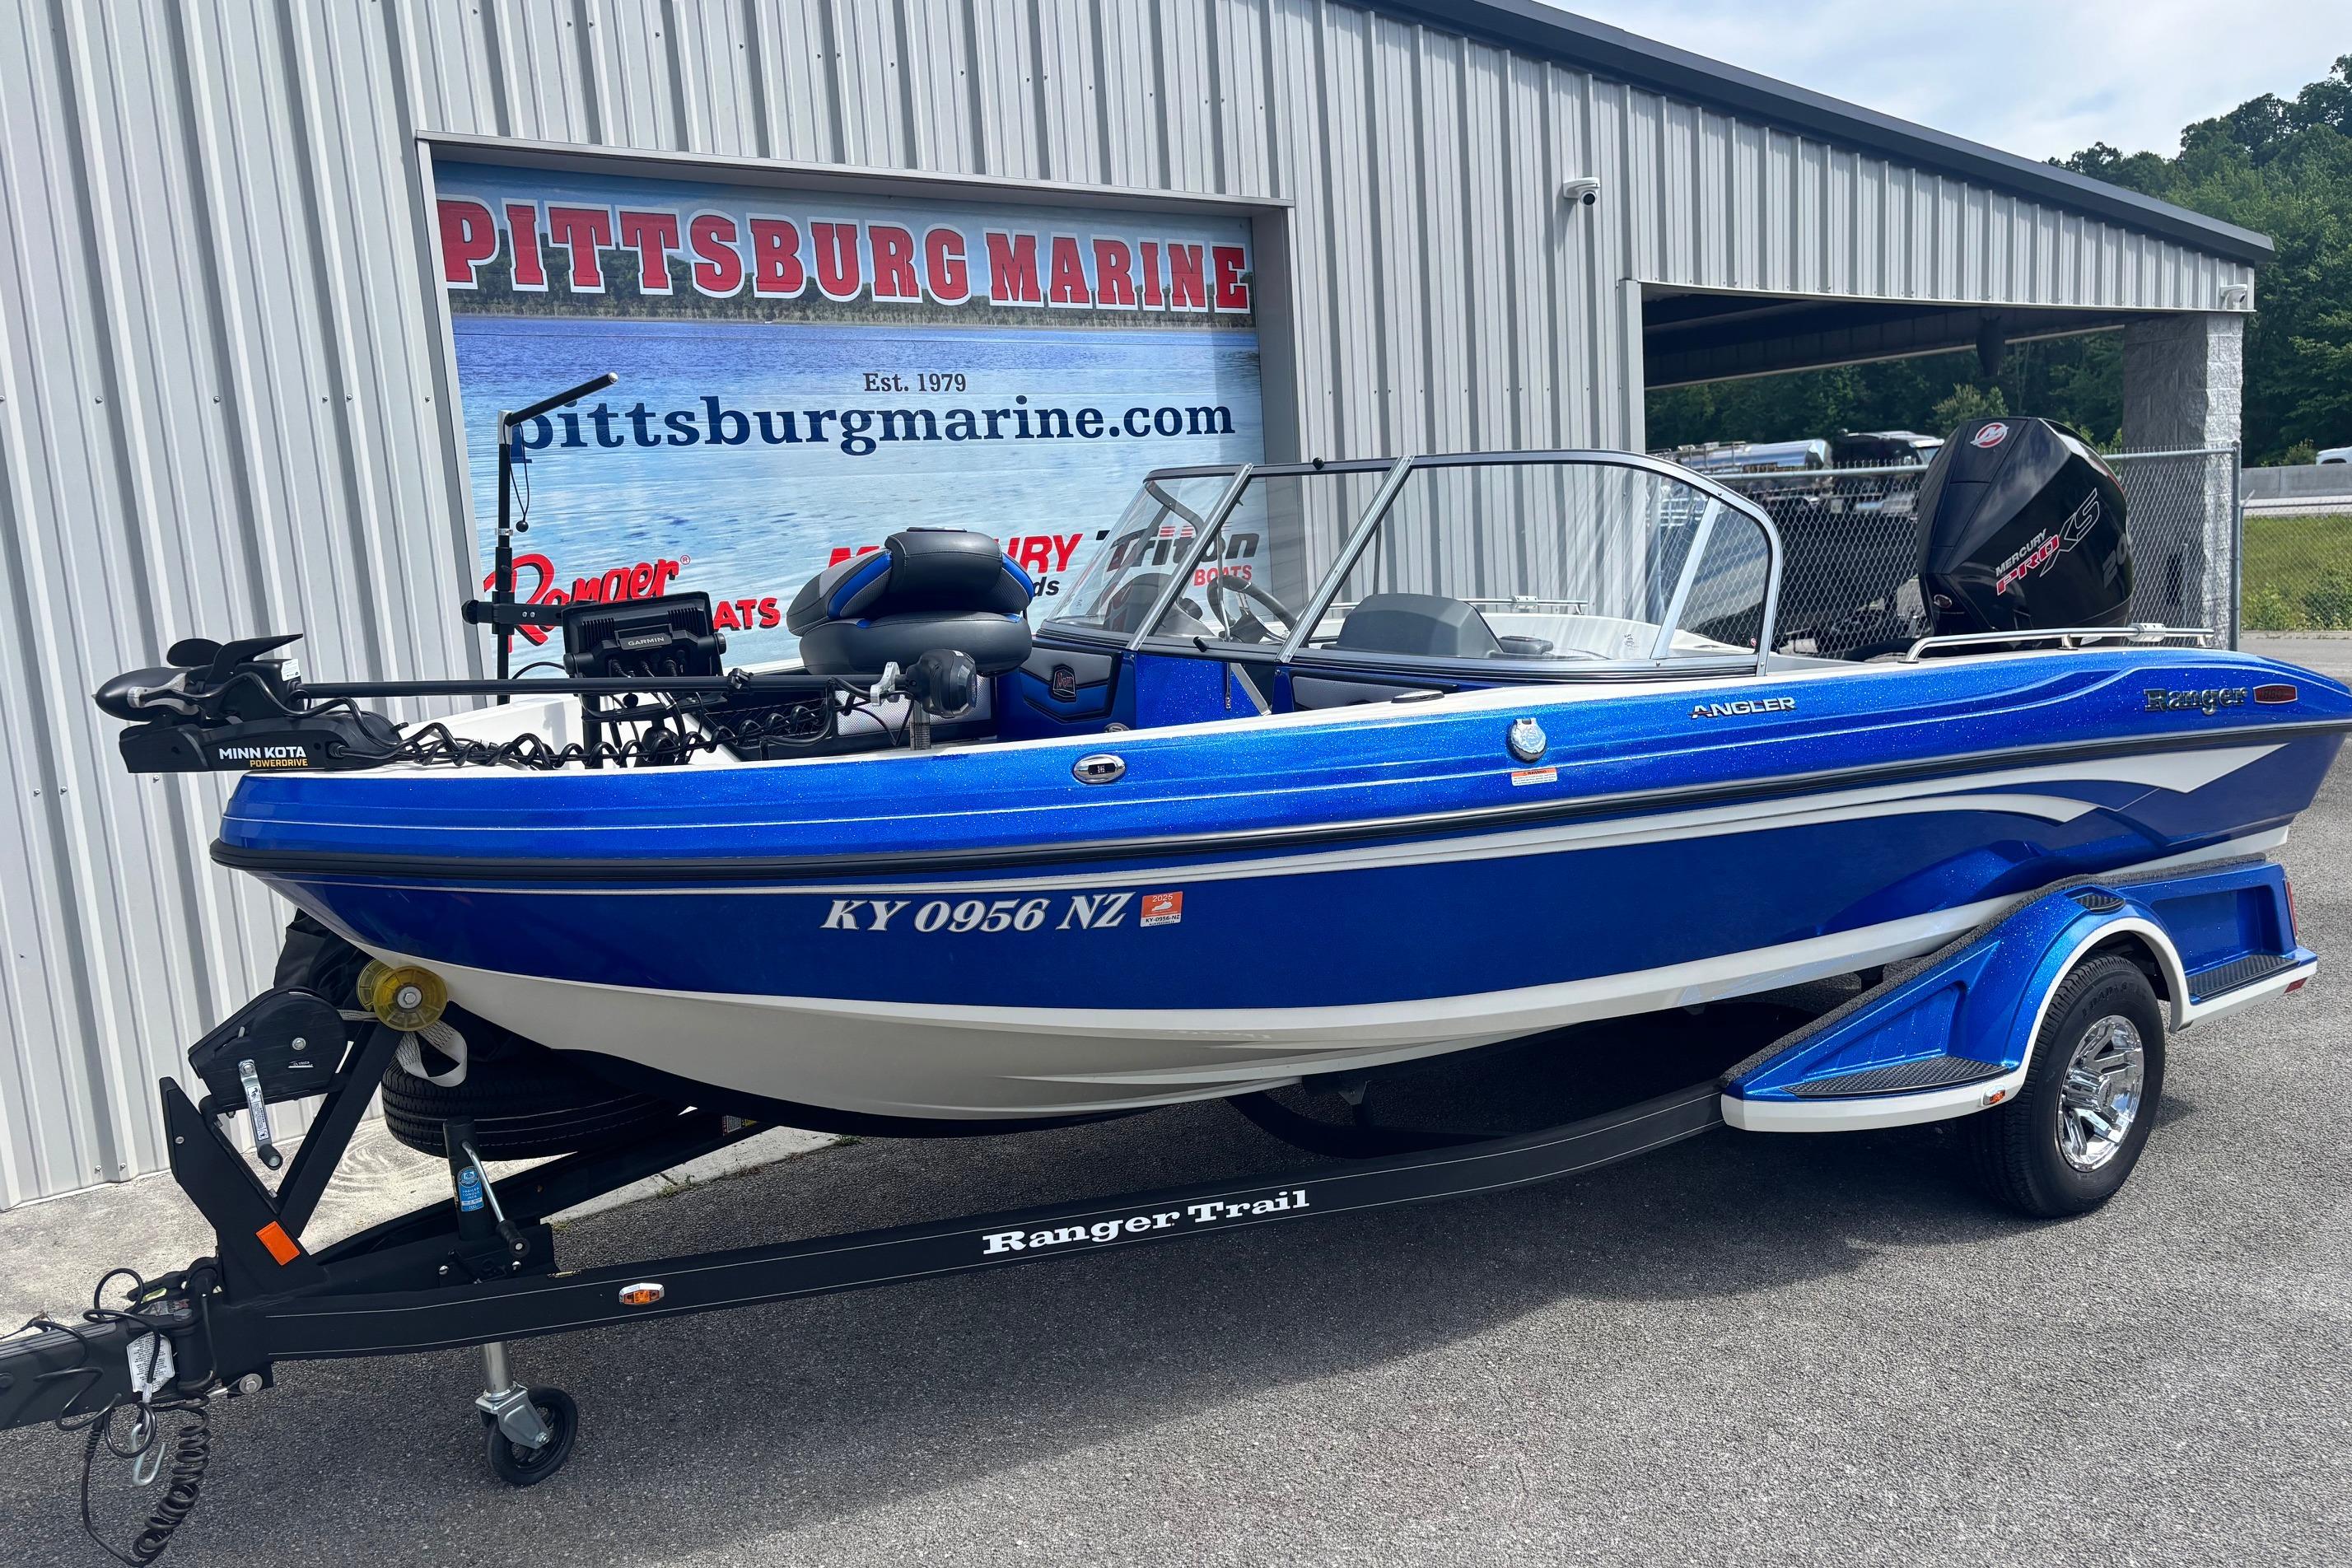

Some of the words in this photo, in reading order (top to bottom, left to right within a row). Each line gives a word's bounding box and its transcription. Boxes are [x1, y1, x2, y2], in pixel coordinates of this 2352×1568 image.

[436, 194, 972, 306] PITTSBURG
[983, 227, 1251, 314] MARINE
[864, 372, 909, 392] Est.
[917, 373, 967, 393] 1979
[510, 394, 1235, 463] pittsburgmarine.com
[1995, 528, 2046, 576] MERCURY
[628, 637, 665, 646] GARMIN
[1689, 697, 1796, 719] ANGLER
[2144, 687, 2248, 716] Ranger
[218, 747, 261, 759] MINN
[264, 746, 306, 758] KOTA
[250, 758, 308, 768] POWERDRIVE
[1153, 894, 1174, 902] 2025
[819, 898, 911, 931] KY
[913, 898, 1052, 932] 0956
[1055, 891, 1136, 930] NZ
[983, 1211, 1180, 1256] Ranger
[1188, 1190, 1309, 1223] Trail
